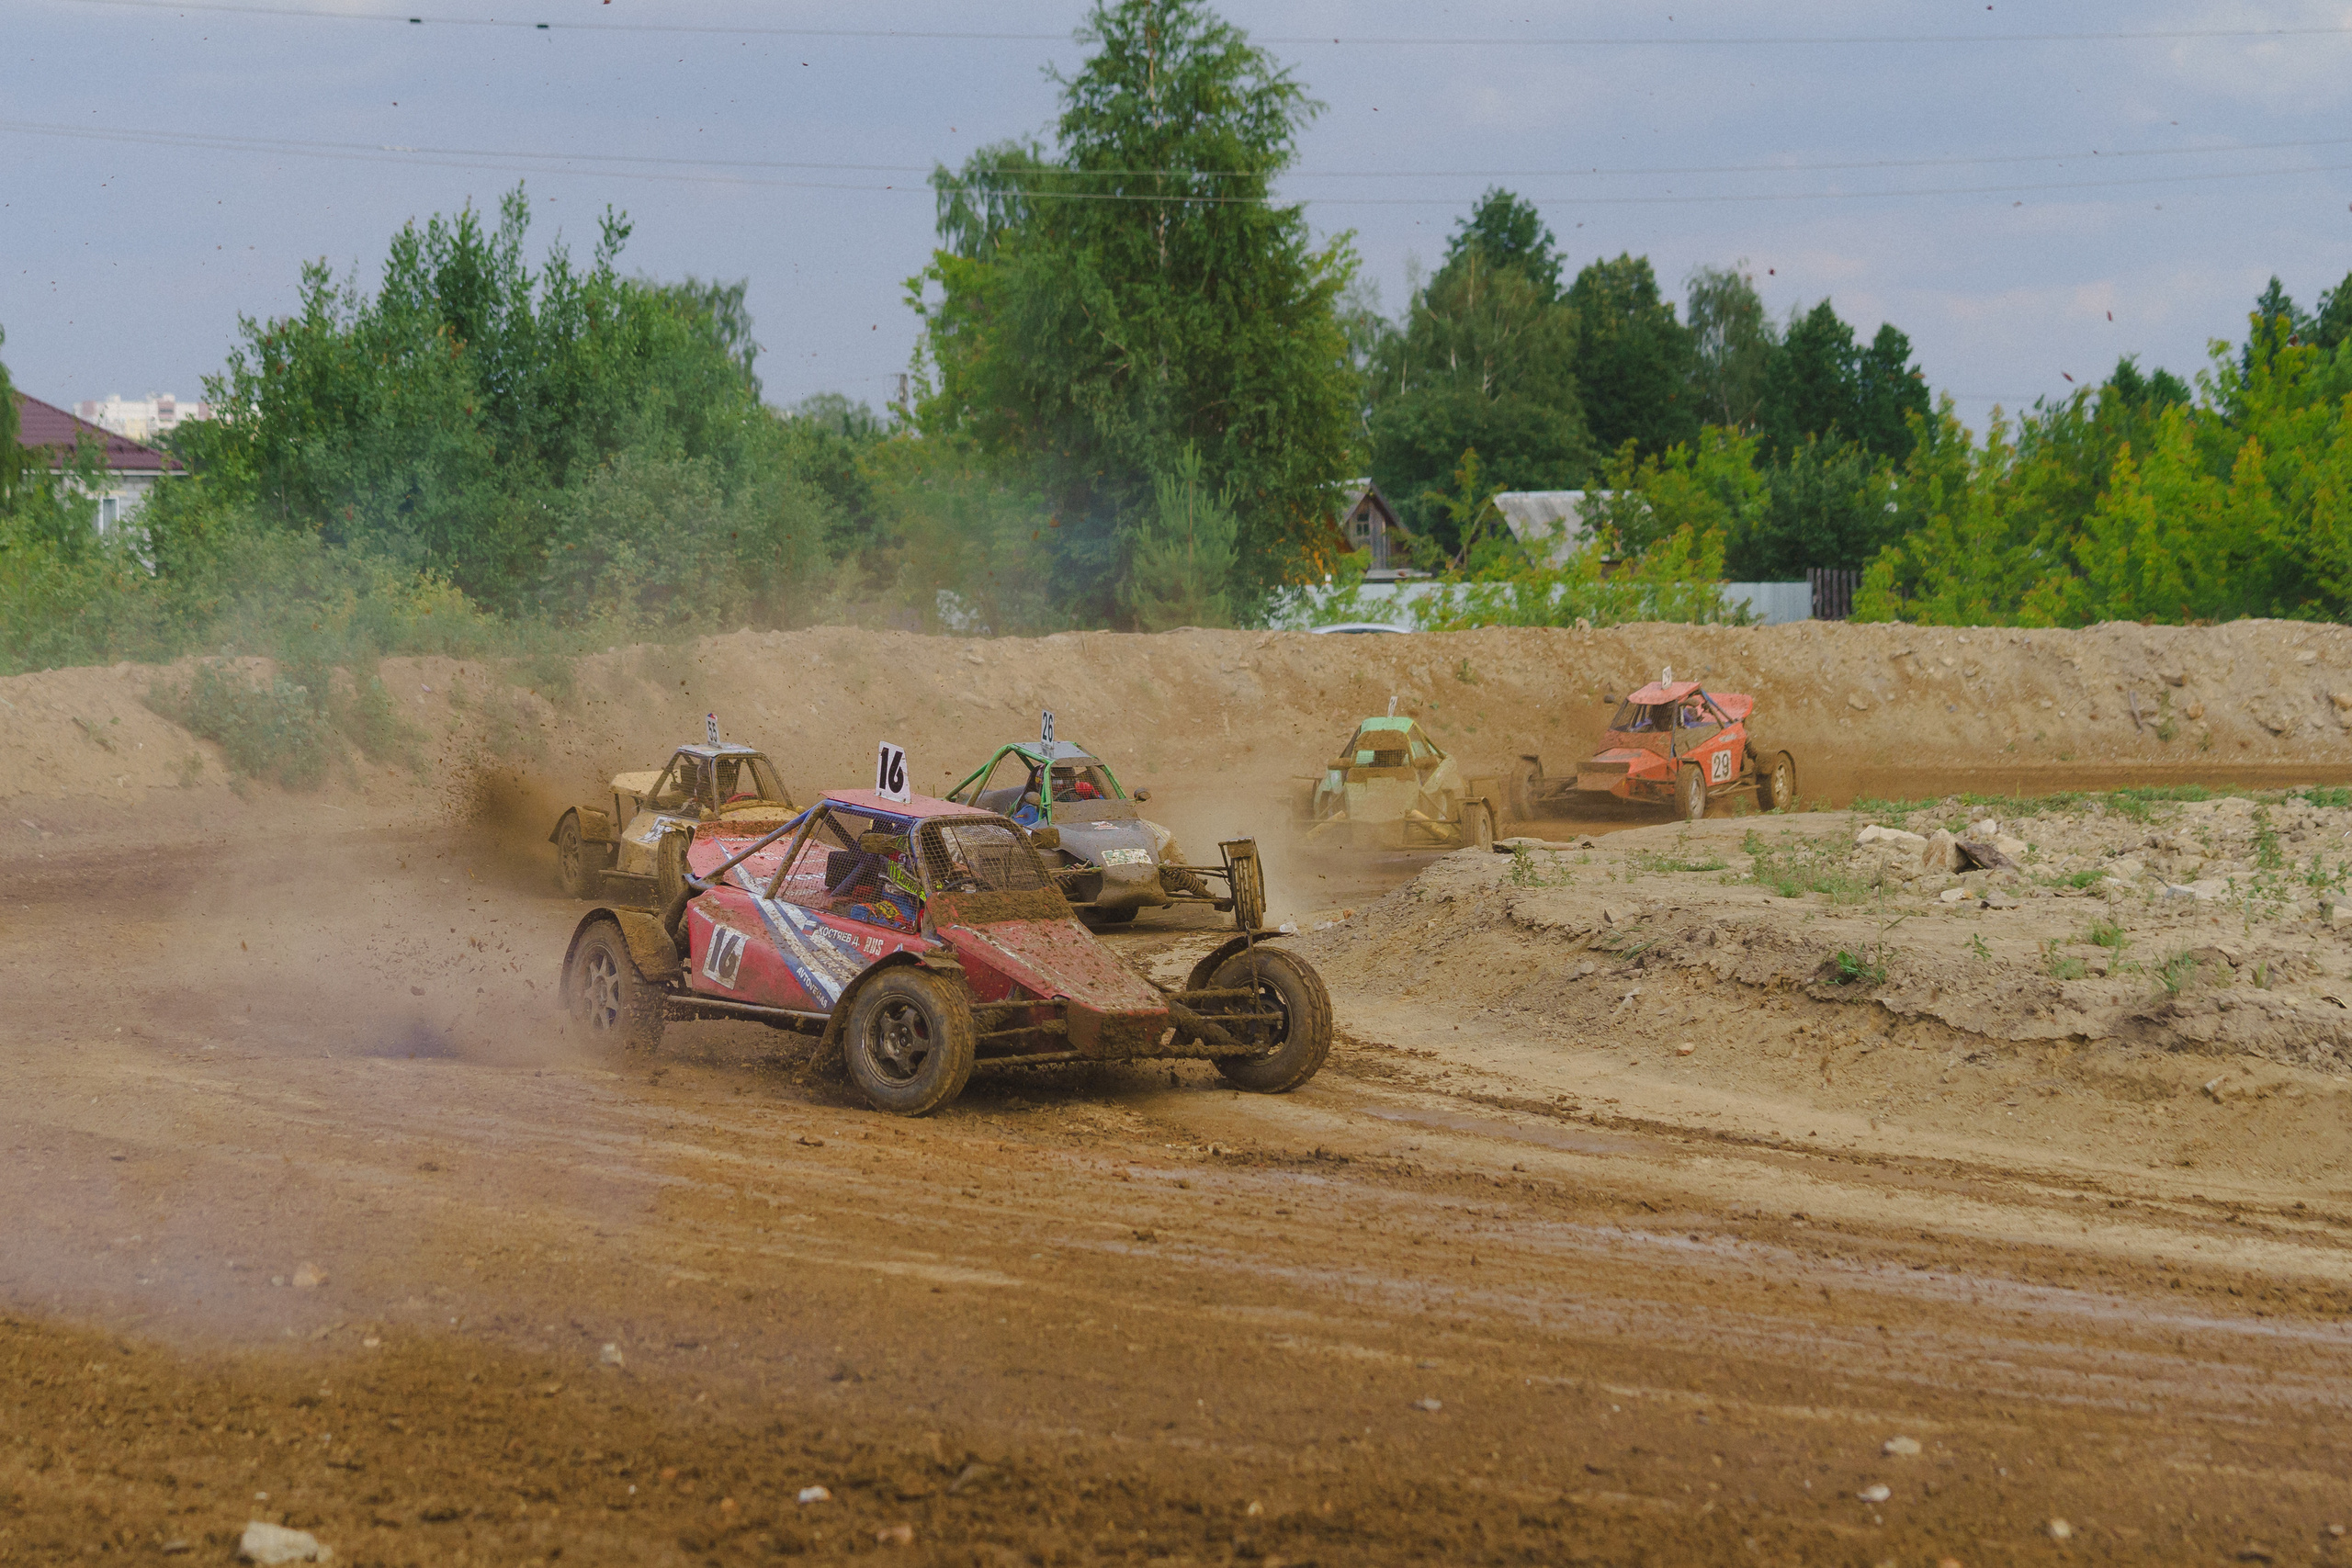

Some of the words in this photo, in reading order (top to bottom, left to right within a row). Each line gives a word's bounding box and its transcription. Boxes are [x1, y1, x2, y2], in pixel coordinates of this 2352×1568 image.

[707, 720, 718, 742] 55
[1042, 711, 1054, 743] 26
[879, 747, 904, 794] 16
[1713, 753, 1729, 779] 29
[708, 927, 741, 978] 16
[819, 925, 853, 943] КОСТЯЕВ
[864, 936, 884, 956] RUS
[796, 966, 828, 1009] AVTOVEGAS
